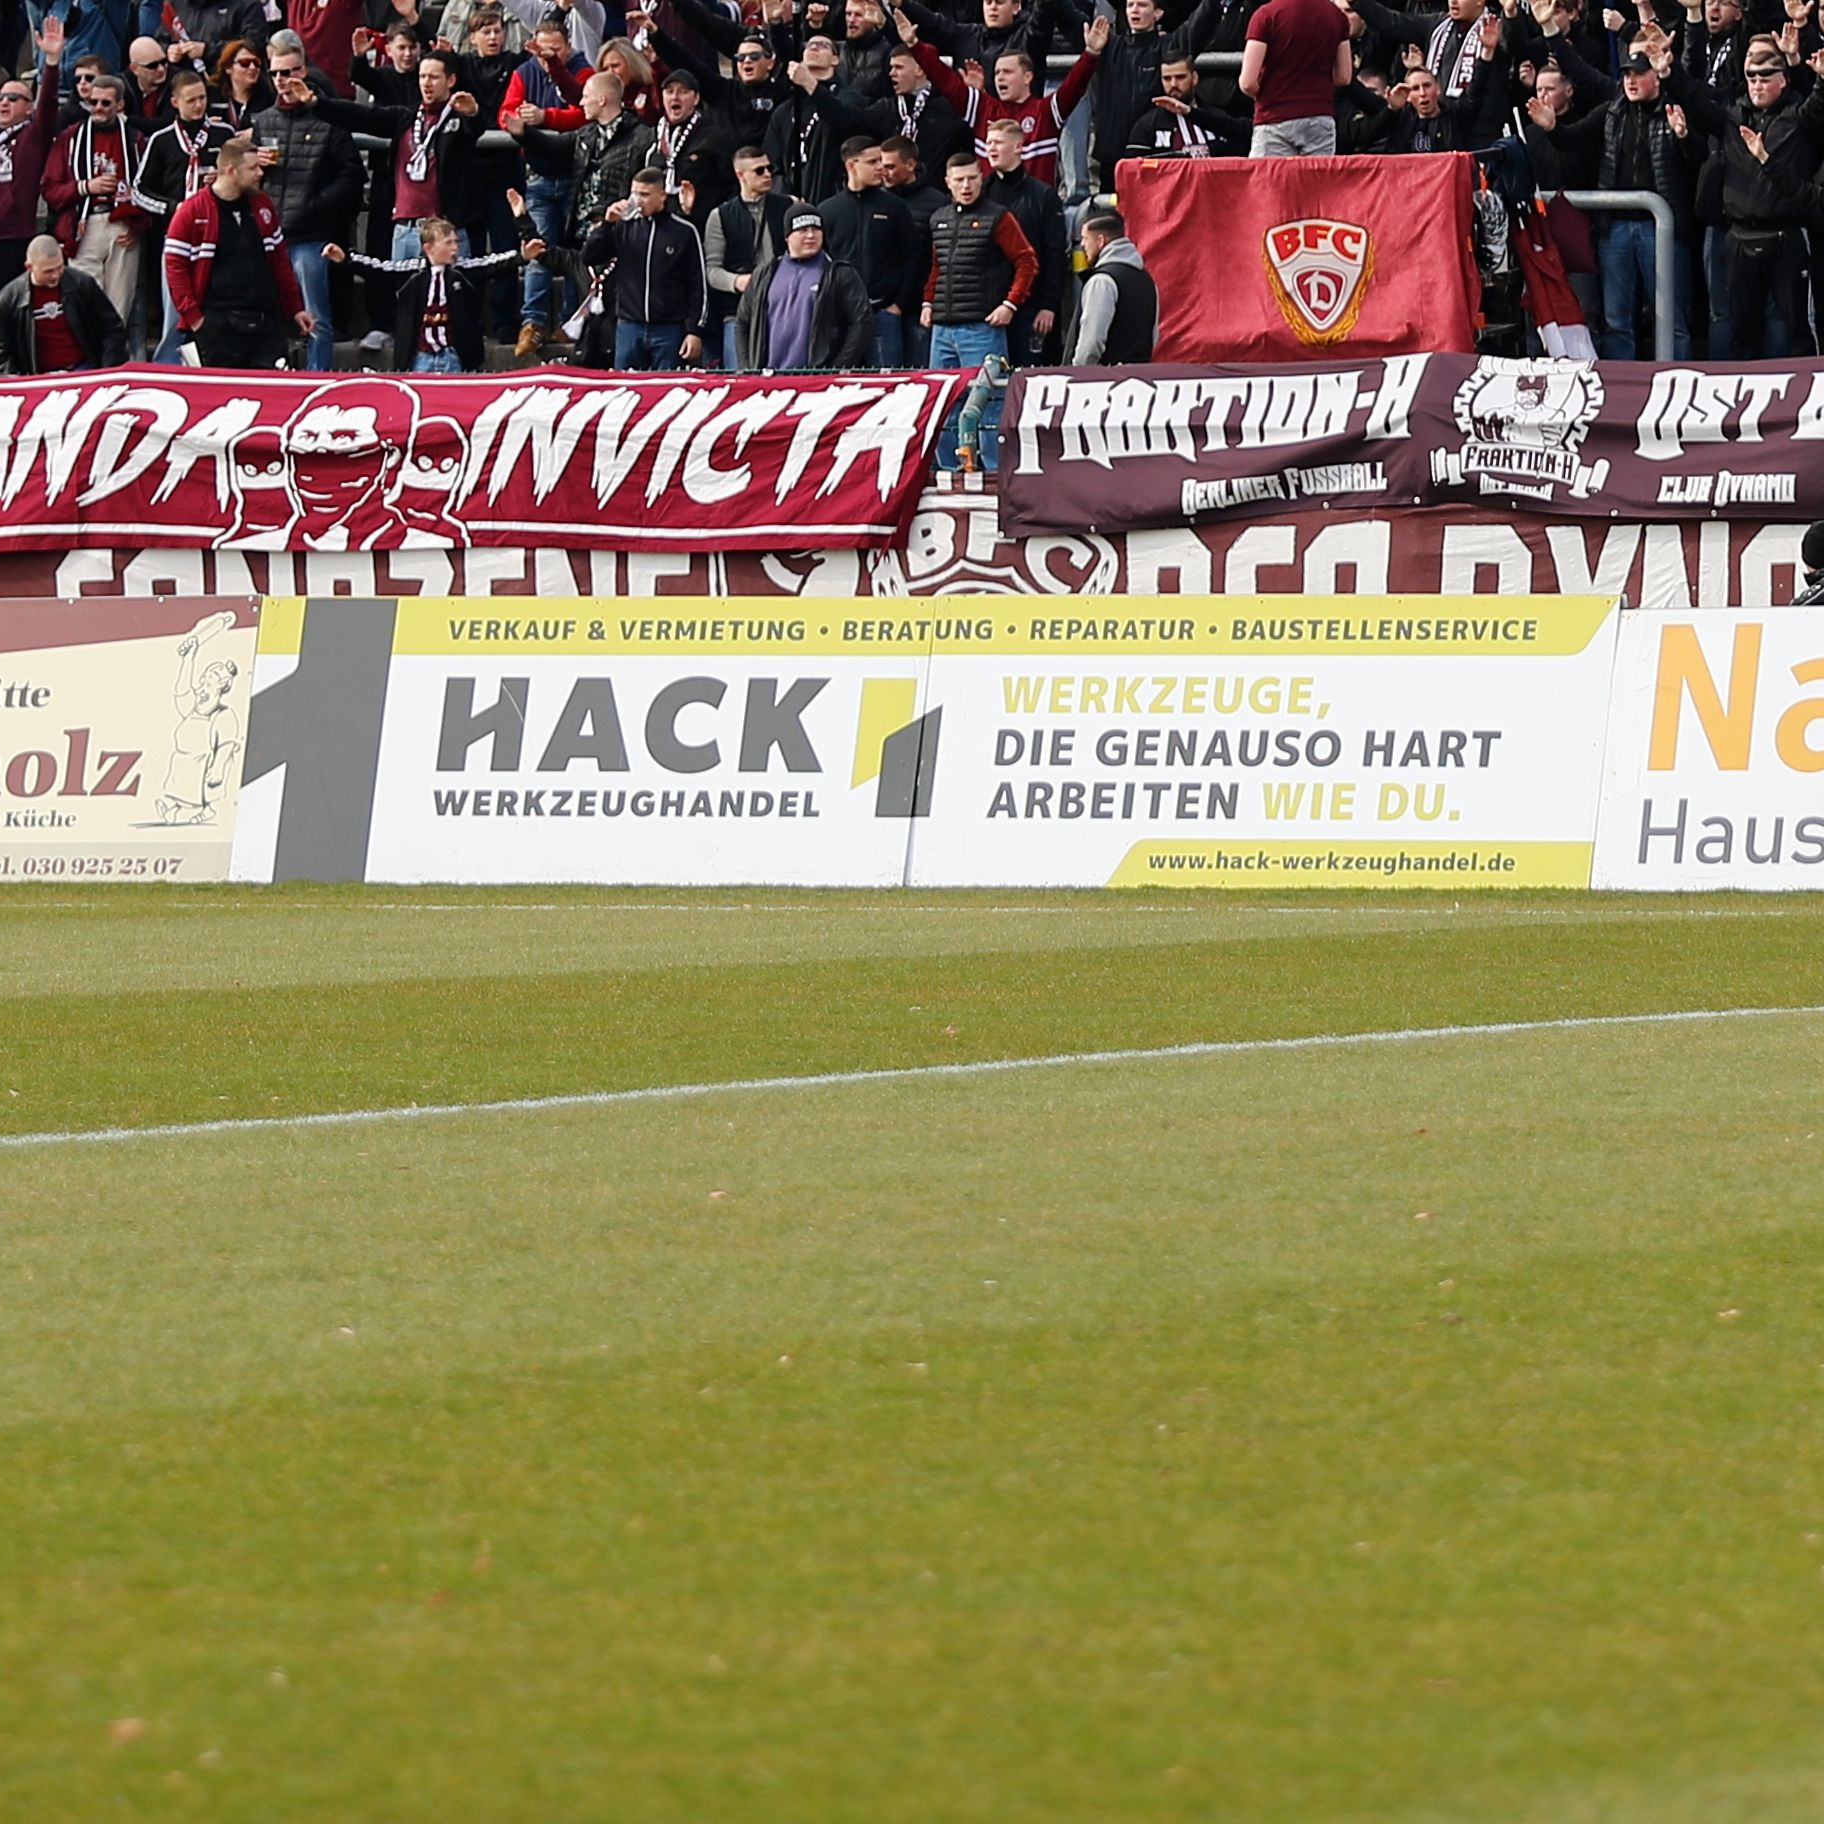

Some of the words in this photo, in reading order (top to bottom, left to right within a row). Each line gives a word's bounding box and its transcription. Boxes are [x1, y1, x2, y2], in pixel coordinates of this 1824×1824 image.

[1272, 225, 1363, 261] BFC
[1013, 351, 1434, 476] FRAKTION-H
[1634, 369, 1795, 462] OST
[456, 383, 929, 511] INVICTA
[1181, 469, 1284, 516] BERLINER
[1284, 461, 1389, 499] FUSSBALL
[1657, 474, 1712, 503] CLUB
[1712, 468, 1797, 507] DYNAMO
[448, 619, 578, 642] VERKAUF
[587, 619, 607, 641] &
[619, 619, 807, 642] VERMIETUNG
[842, 619, 994, 642] BERATUNG
[1029, 619, 1196, 642] REPARATUR
[1231, 619, 1538, 642] BAUSTELLENSERVICE
[1001, 675, 1333, 721] WERKZEUGE,
[436, 676, 832, 773] HACK
[993, 729, 1076, 767] DIE
[1095, 728, 1342, 768] GENAUSO
[1362, 730, 1502, 768] HART
[3, 808, 77, 830] Küche
[433, 789, 821, 818] WERKZEUGHANDEL
[986, 782, 1239, 819] ARBEITEN
[1261, 782, 1355, 819] WIE
[1377, 783, 1462, 821] DU.
[21, 856, 66, 877] 030
[70, 856, 115, 877] 925
[118, 856, 148, 877] 25
[151, 856, 183, 877] 07
[1147, 851, 1516, 875] www.hack-werkzeughandel.de
